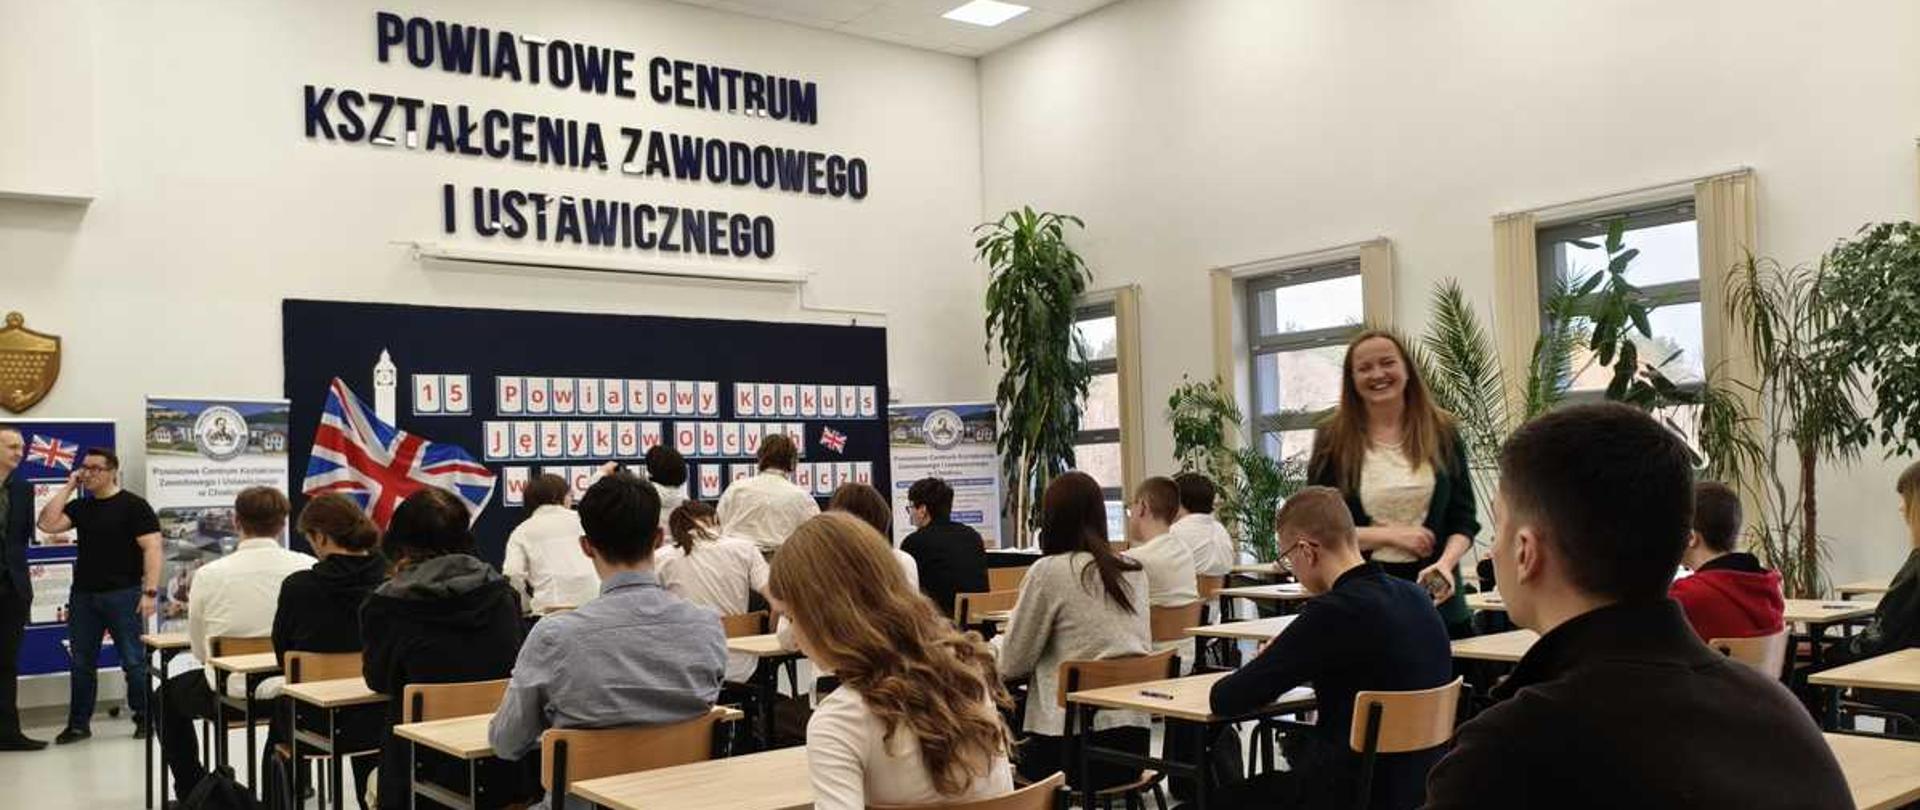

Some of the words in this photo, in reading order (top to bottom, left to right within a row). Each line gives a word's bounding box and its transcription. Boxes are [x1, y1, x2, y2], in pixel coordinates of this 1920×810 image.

[376, 12, 636, 98] POWIATOWE
[649, 56, 818, 125] CENTRUM
[304, 85, 608, 169] KSZTAŁCENIA
[620, 127, 868, 200] ZAWODOWEGO
[444, 183, 456, 234] I
[473, 187, 775, 259] USTAWICZNEGO
[423, 384, 463, 402] 15
[505, 386, 713, 410] Powiatowy
[740, 391, 872, 409] Konkurs
[493, 429, 659, 452] Języków
[679, 430, 801, 449] Obcyh
